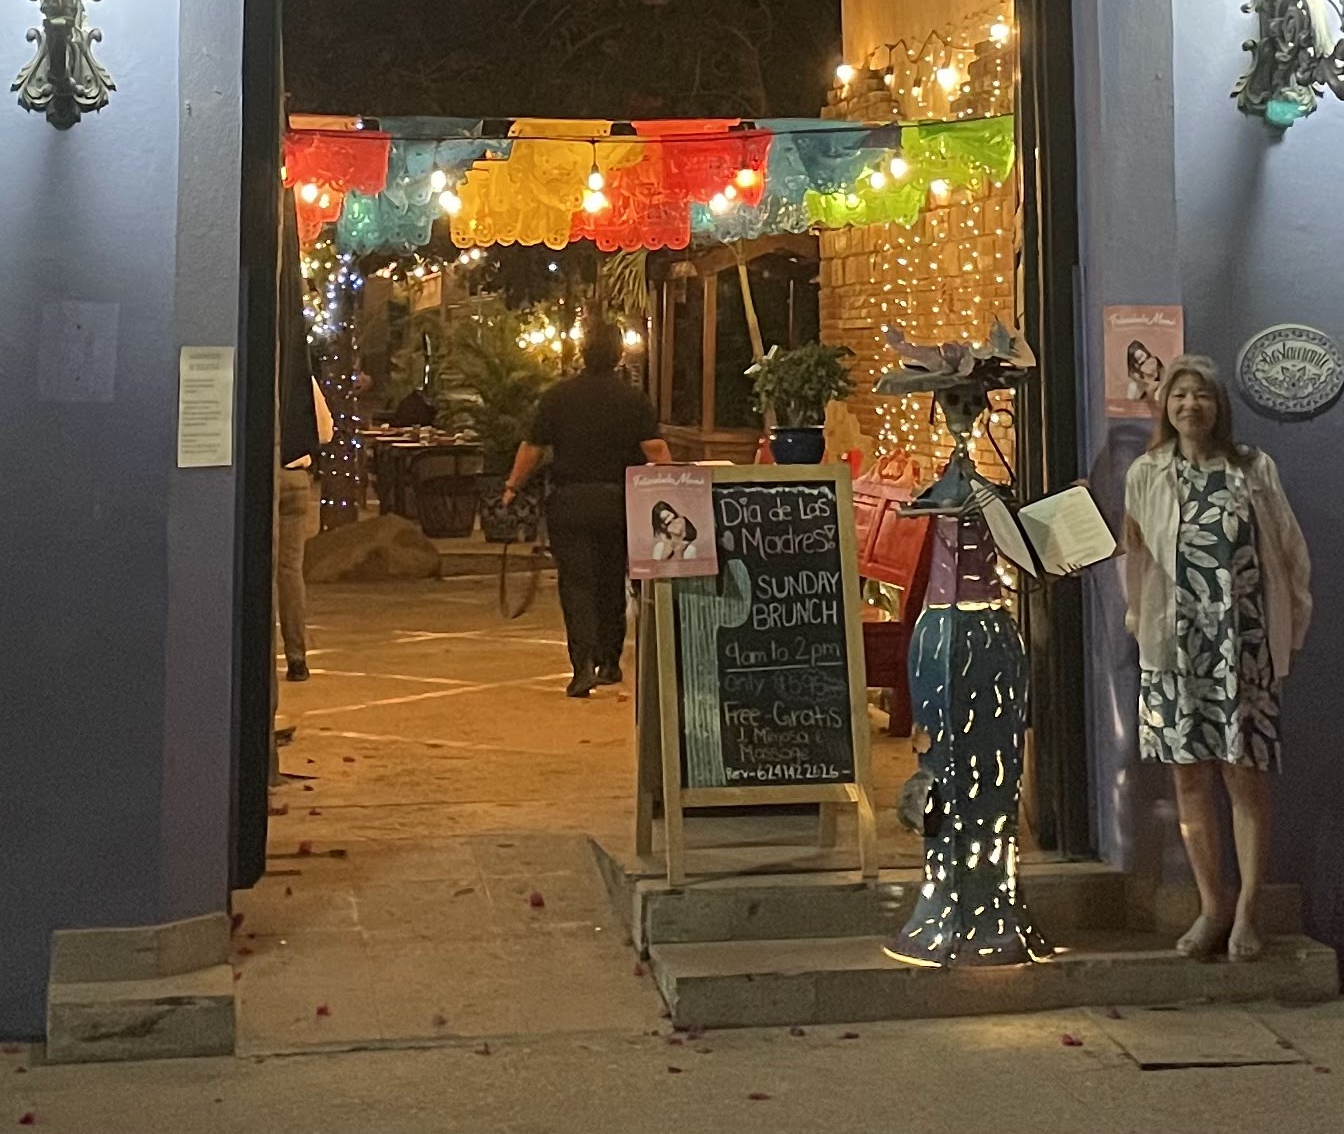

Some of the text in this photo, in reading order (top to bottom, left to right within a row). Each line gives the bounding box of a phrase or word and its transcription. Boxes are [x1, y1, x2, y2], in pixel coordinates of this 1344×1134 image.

[768, 497, 792, 521] de
[798, 496, 830, 520] Las
[756, 570, 840, 599] SUNDAY
[752, 598, 838, 631] BRUNCH
[725, 641, 767, 666] 9am
